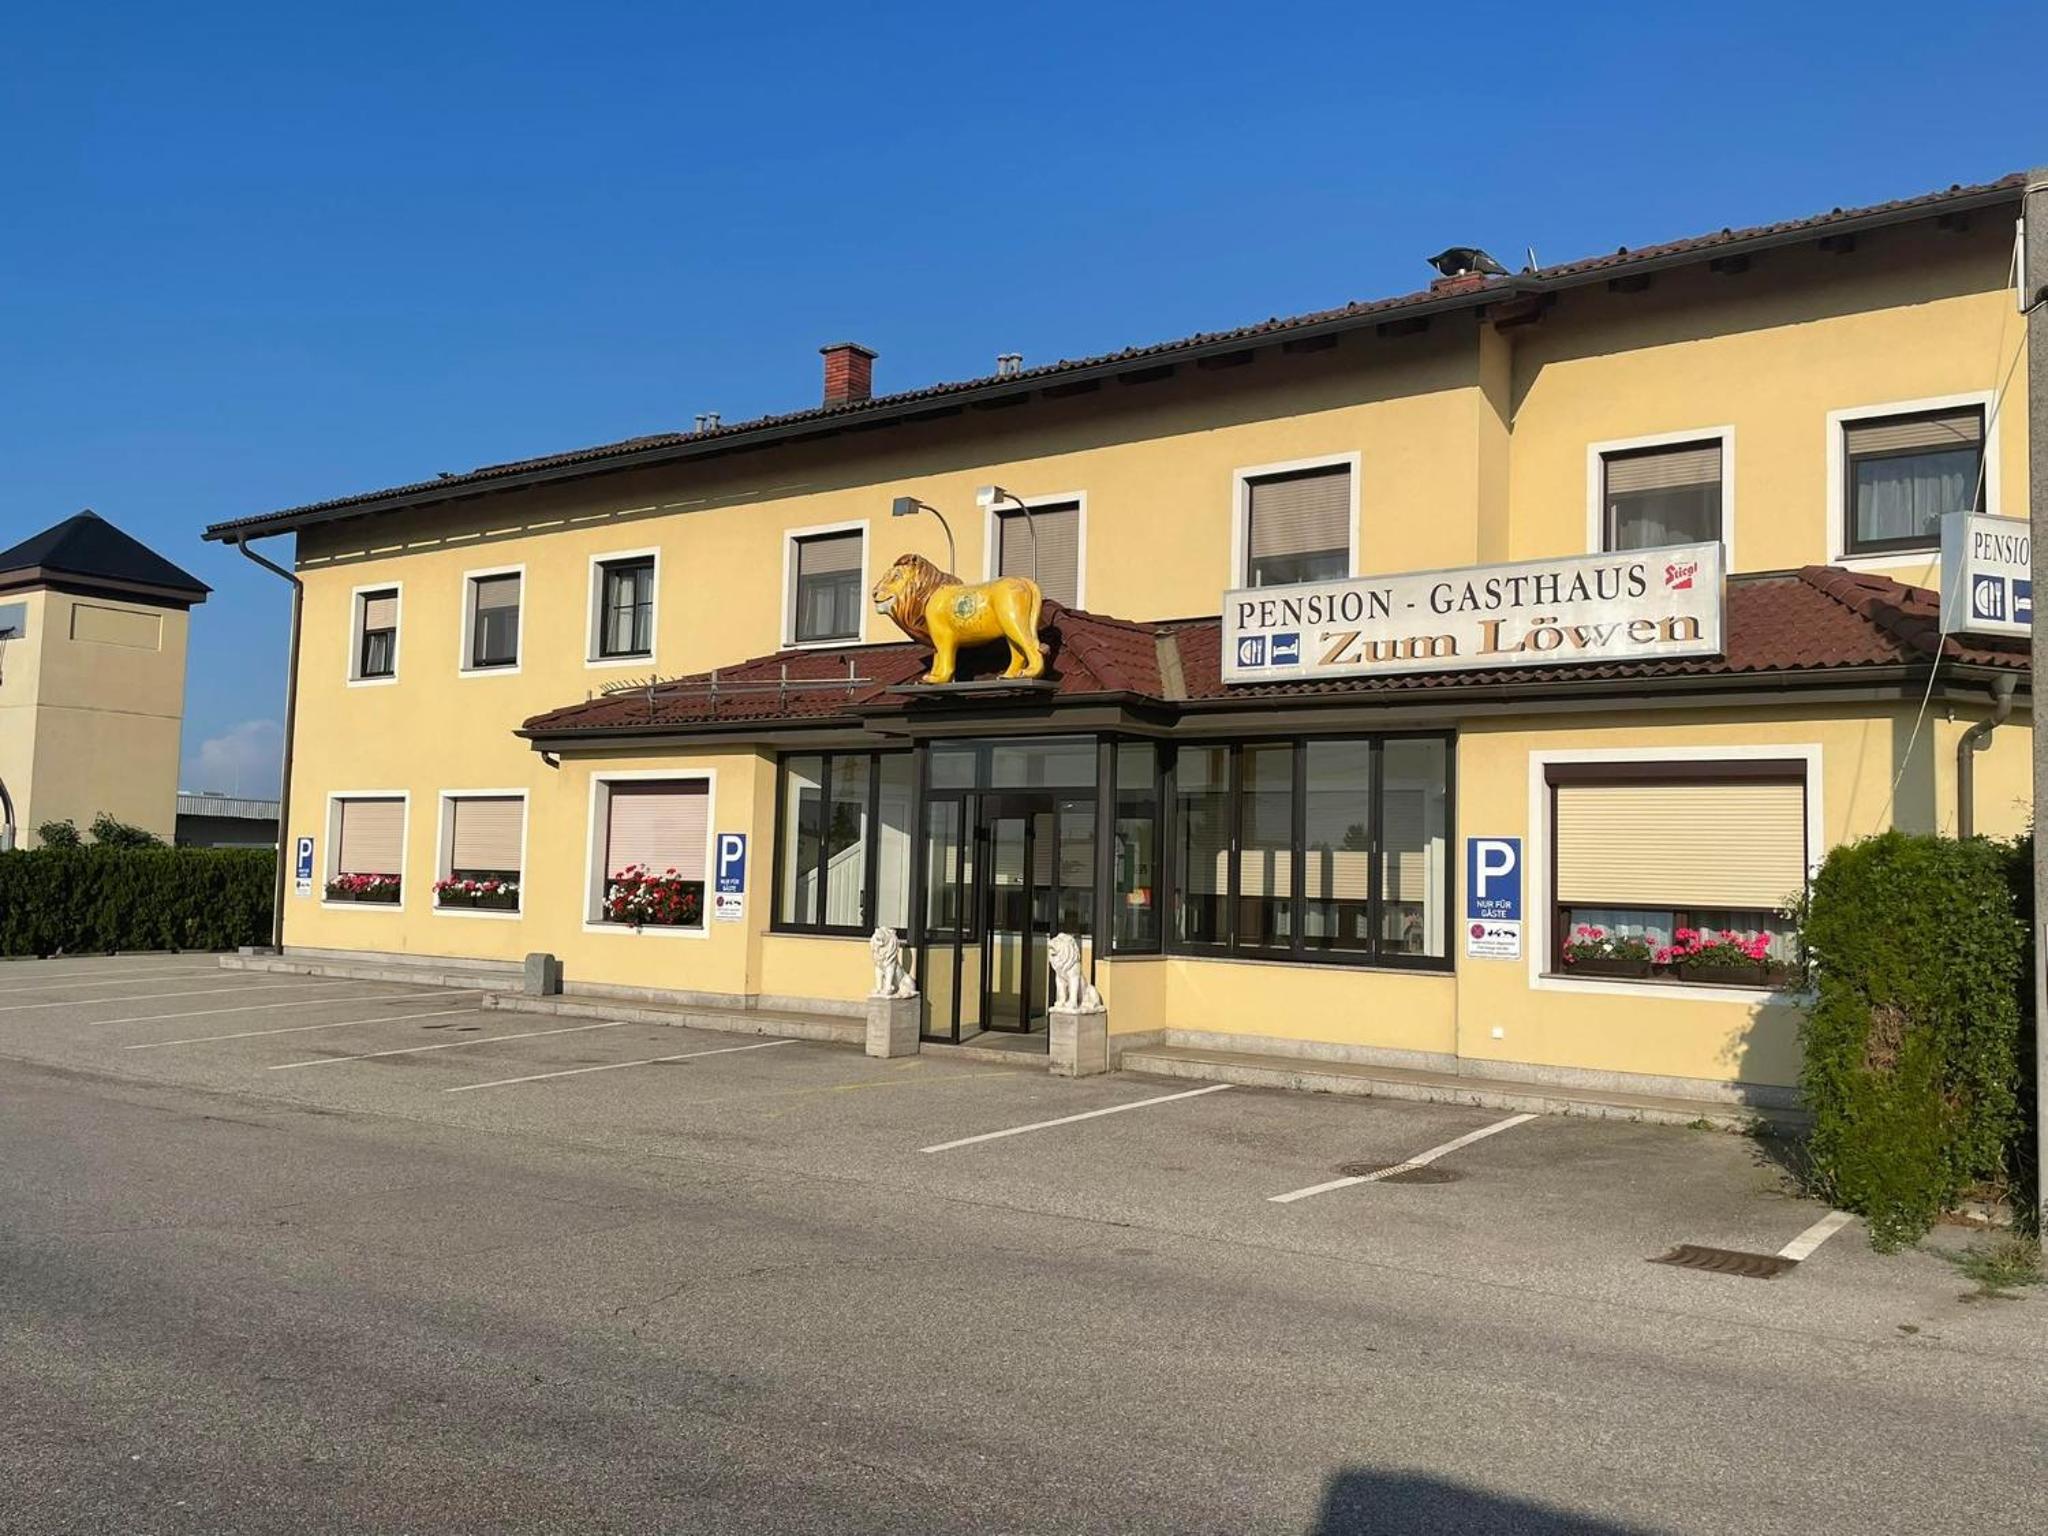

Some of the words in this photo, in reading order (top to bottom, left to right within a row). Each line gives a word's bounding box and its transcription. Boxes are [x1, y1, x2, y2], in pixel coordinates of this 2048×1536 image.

[1974, 532, 2030, 566] PENSIO
[1665, 562, 1698, 586] Stiegl
[1237, 589, 1393, 629] PENSION
[1430, 564, 1646, 614] GASTHAUS
[1318, 630, 1461, 666] Zum
[1476, 615, 1704, 655] Löwen
[298, 839, 312, 868] P
[720, 835, 743, 877] P
[1476, 841, 1516, 898] P
[1476, 900, 1494, 909] NUR
[1495, 899, 1512, 909] FÜR
